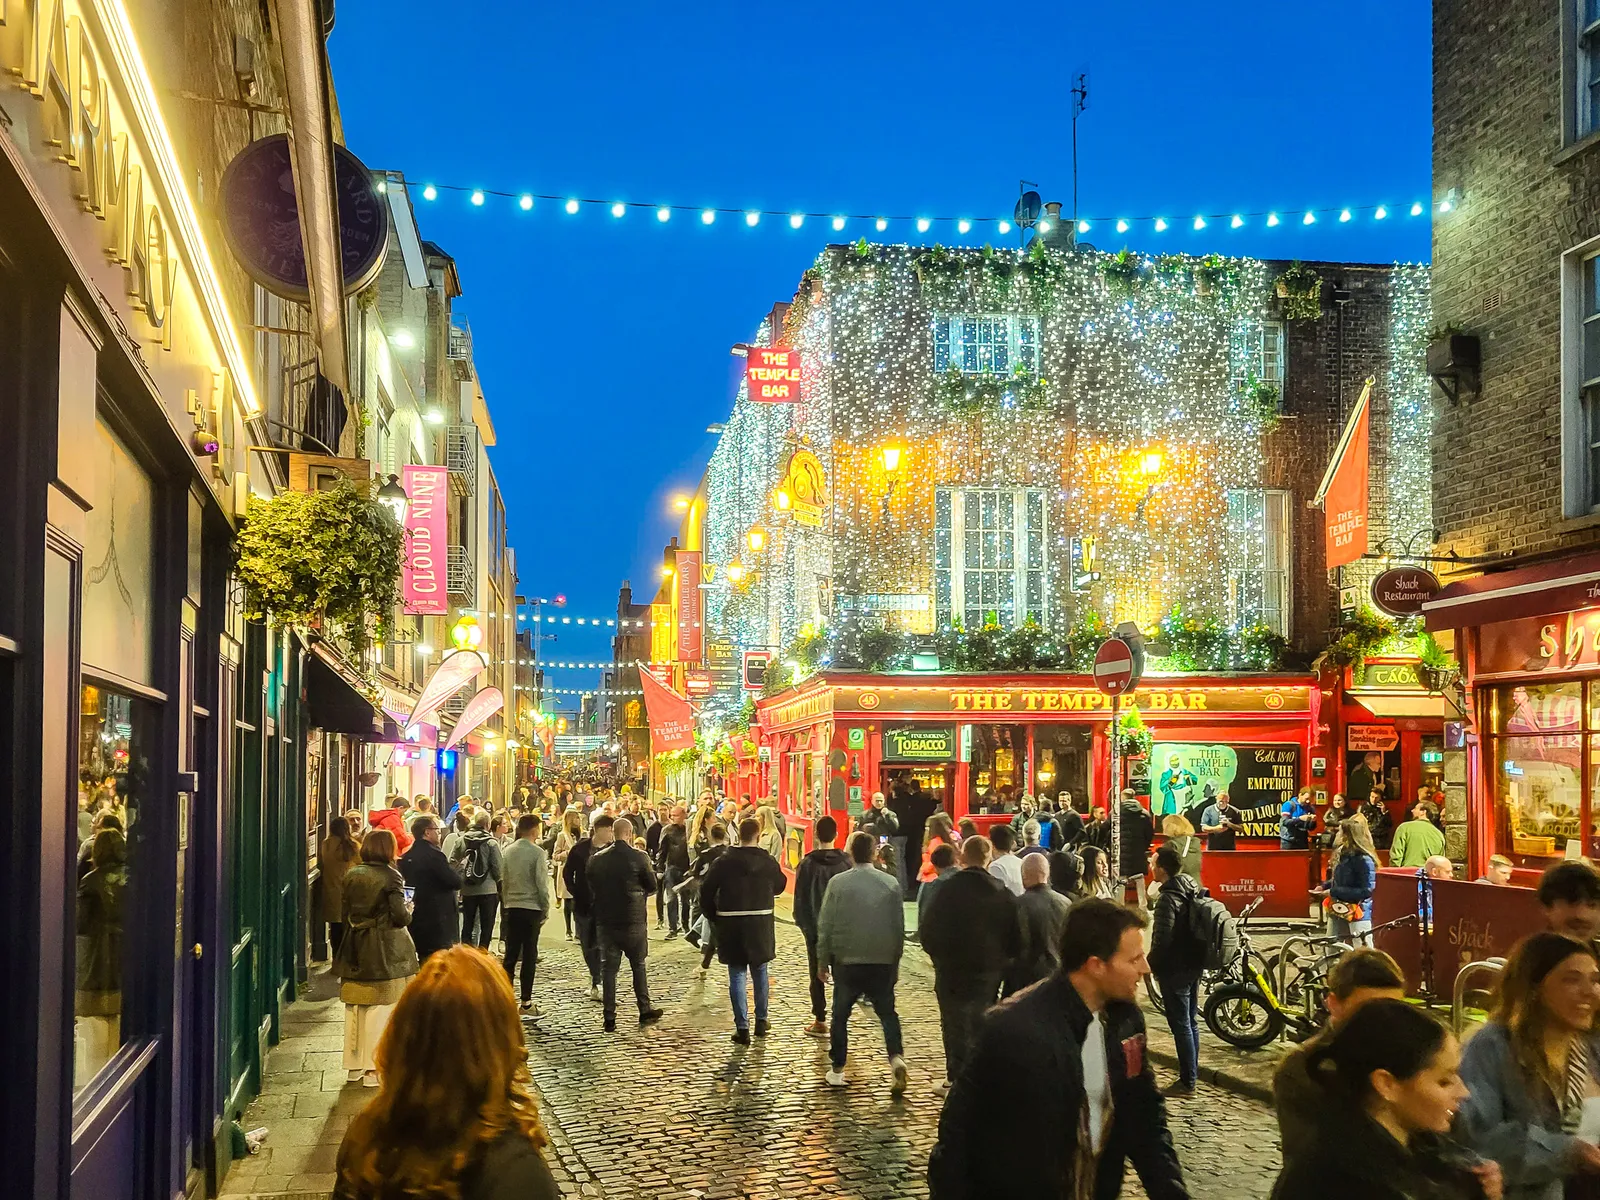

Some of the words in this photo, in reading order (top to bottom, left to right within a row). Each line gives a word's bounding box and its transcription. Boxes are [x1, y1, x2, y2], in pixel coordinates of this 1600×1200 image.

[761, 352, 789, 366] THE
[749, 367, 800, 381] TEMPLE
[761, 384, 789, 398] BAR
[412, 471, 438, 519] NINE
[1337, 510, 1353, 522] THE
[1328, 515, 1364, 538] TEMPLE
[412, 526, 438, 593] CLOUD
[682, 566, 690, 585] BAR
[1395, 575, 1419, 590] Shack
[1384, 592, 1430, 601] Restaurant
[682, 628, 690, 646] THE
[862, 696, 875, 704] 48
[950, 693, 1012, 710] THE
[1022, 693, 1136, 710] TEMPLE
[1149, 693, 1208, 710] BAR
[1268, 697, 1280, 706] 48
[654, 724, 690, 736] TEMPLE
[664, 733, 683, 741] BAR
[1350, 735, 1376, 744] Smoking
[893, 736, 946, 754] TOBACCO
[1199, 750, 1220, 758] THE
[1189, 758, 1230, 768] TEMPLE
[1200, 767, 1220, 776] BAR
[1272, 765, 1294, 778] THE
[1248, 778, 1294, 790] EMPEROR
[1281, 790, 1294, 802] OF
[1240, 808, 1254, 822] ED
[1255, 804, 1282, 820] LIQUO
[1235, 822, 1282, 837] NNES
[1220, 884, 1254, 892] TEMPLE
[1449, 918, 1494, 950] Shack
